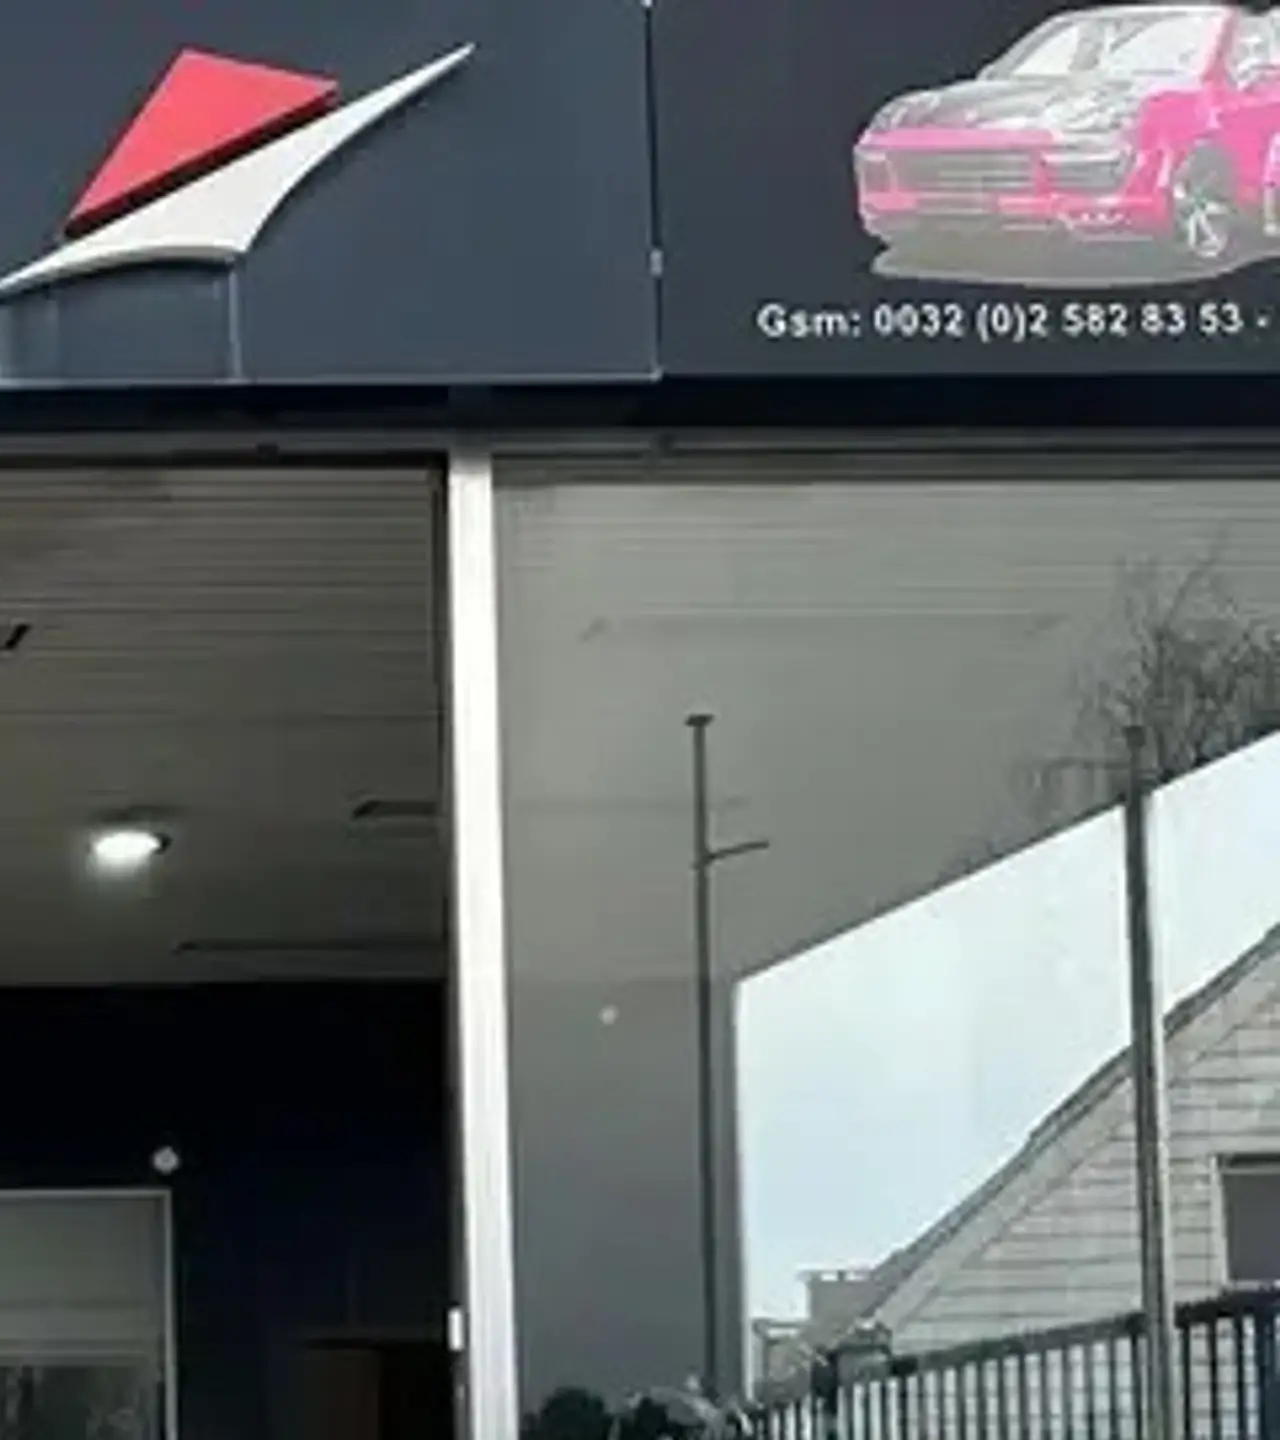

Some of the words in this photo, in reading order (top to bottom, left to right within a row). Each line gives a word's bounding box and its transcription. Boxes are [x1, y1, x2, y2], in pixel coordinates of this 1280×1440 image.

[756, 303, 861, 338] Gsm:
[873, 303, 964, 338] 0032
[1062, 303, 1128, 336] 582
[1141, 303, 1186, 335] 83
[1199, 303, 1244, 335] 53
